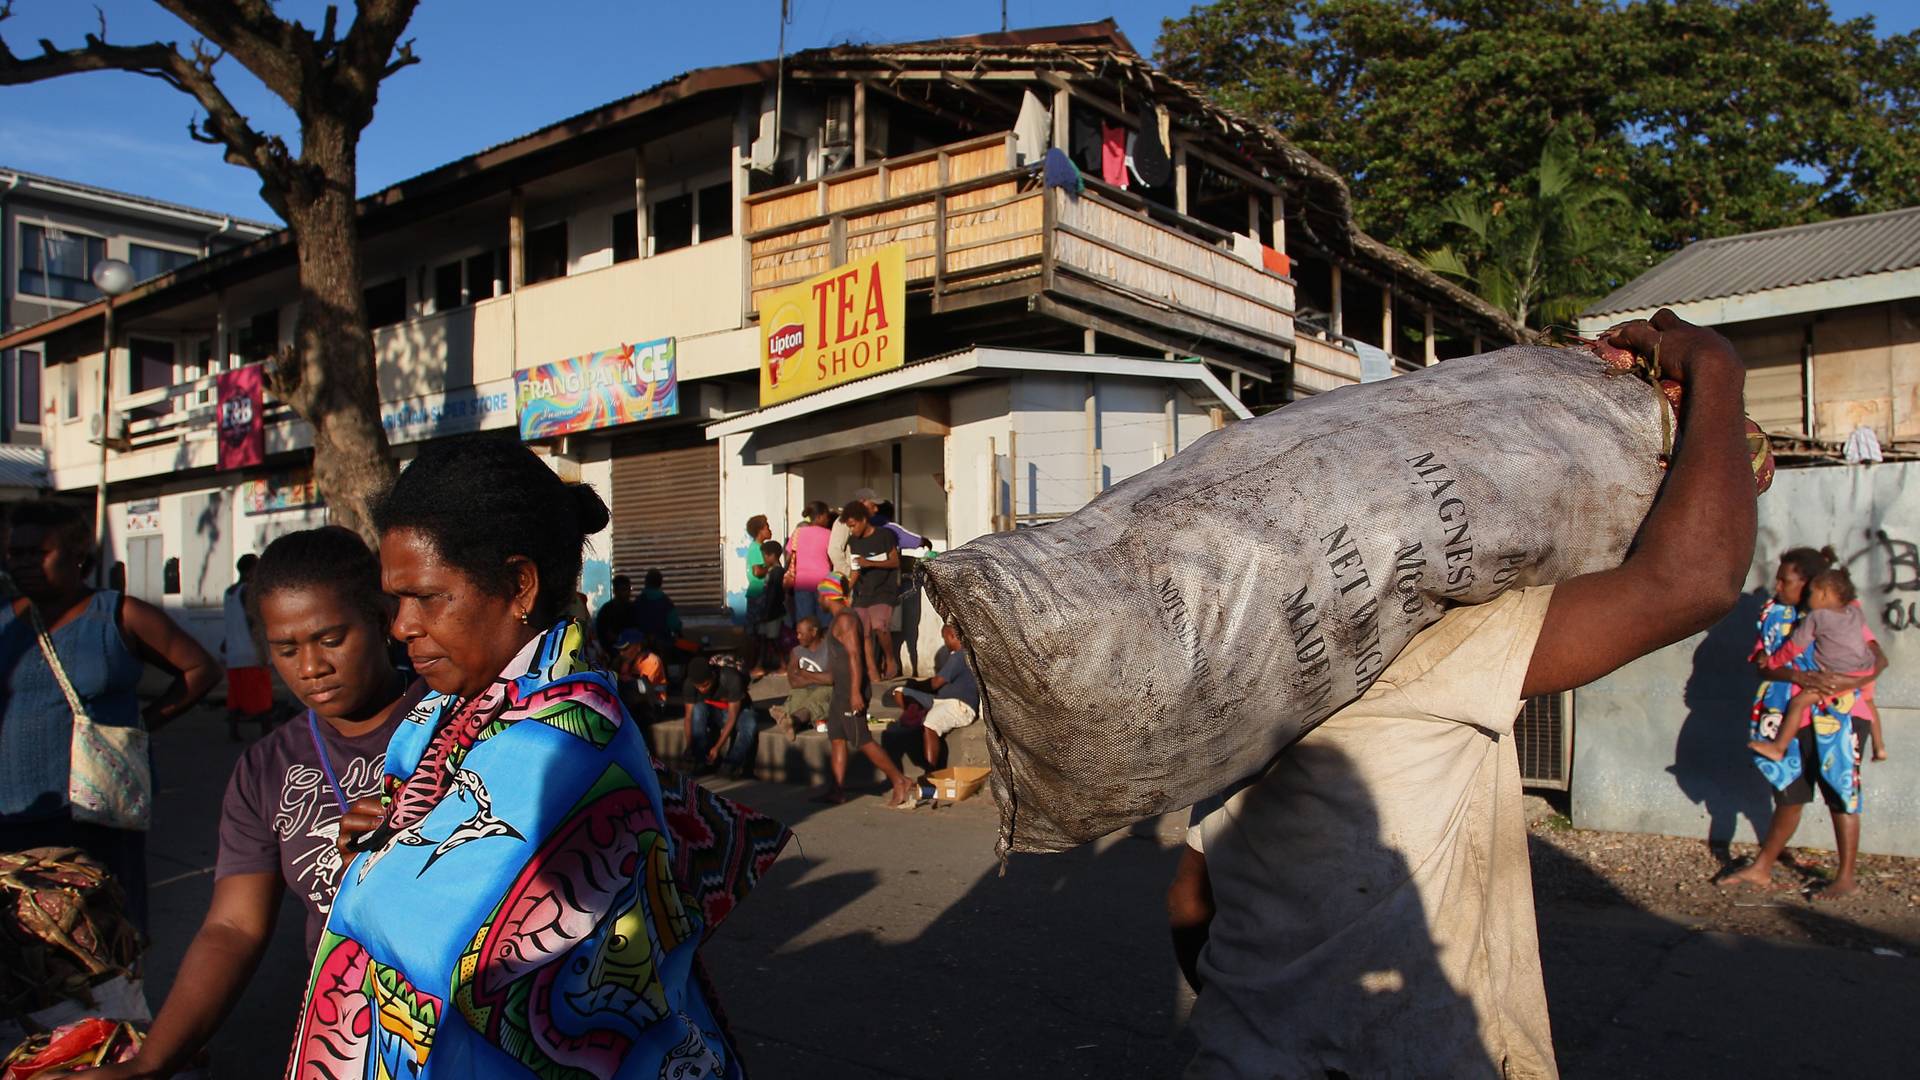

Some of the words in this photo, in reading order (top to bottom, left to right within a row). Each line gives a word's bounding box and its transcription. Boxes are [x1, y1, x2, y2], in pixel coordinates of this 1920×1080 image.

[812, 261, 888, 350] TEA
[628, 343, 669, 386] ICE
[770, 331, 802, 355] Lipton
[817, 335, 888, 381] SHOP
[382, 407, 428, 429] RISTIAN
[431, 400, 466, 422] SUPER
[471, 393, 507, 415] STORE
[1156, 577, 1185, 613] NOT
[1320, 523, 1371, 597] NET
[1350, 596, 1383, 694] WEIGH
[1282, 584, 1330, 683] MADE
